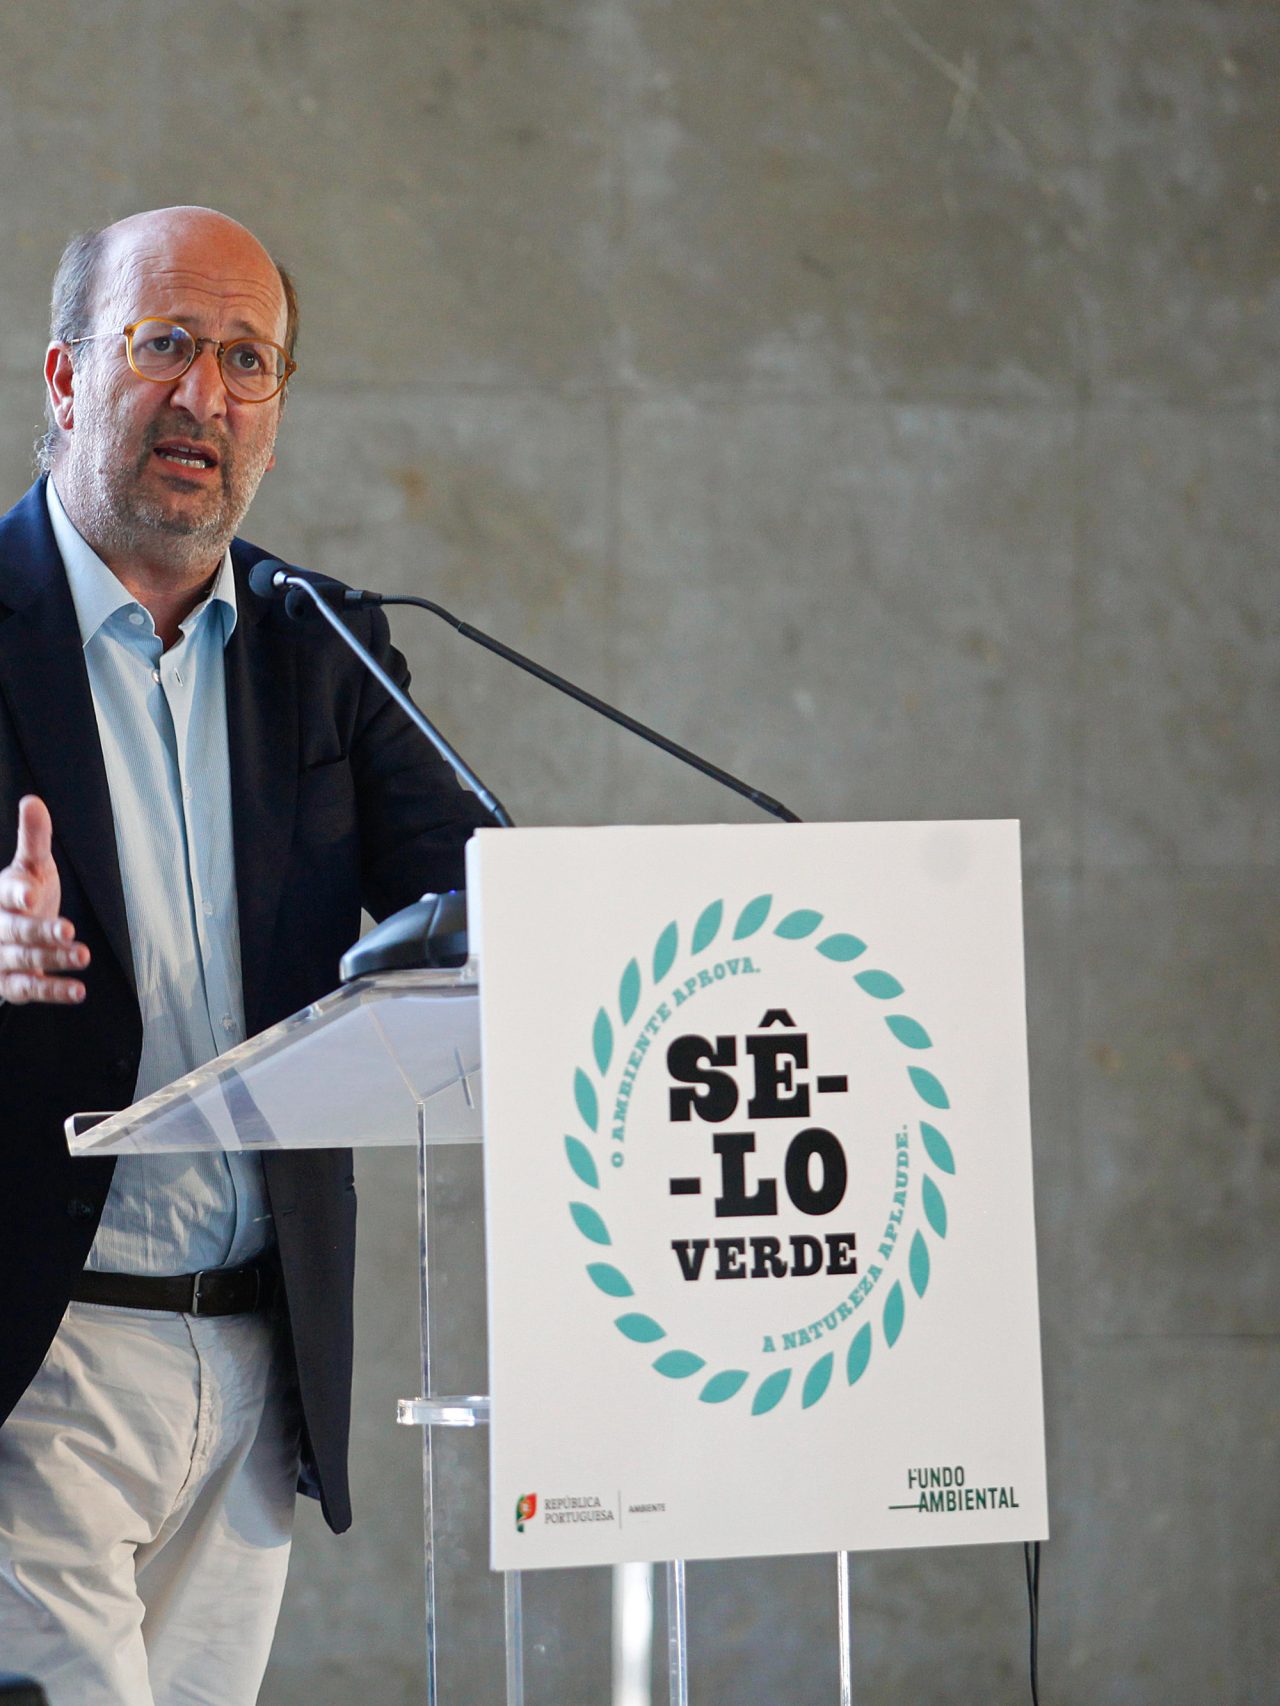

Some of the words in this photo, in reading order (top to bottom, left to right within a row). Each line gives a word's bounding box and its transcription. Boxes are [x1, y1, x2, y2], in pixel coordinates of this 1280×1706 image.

[671, 956, 761, 1007] APROVA.
[611, 1001, 673, 1143] AMBIENTE
[666, 1008, 848, 1123] SÊ-
[611, 1151, 624, 1168] O
[669, 1127, 848, 1218] -LO
[671, 1232, 857, 1281] VERDE
[762, 1335, 776, 1353] A
[782, 1264, 883, 1350] NATUREZA
[878, 1124, 909, 1261] APLAUDE.
[908, 1466, 966, 1489] FUNDO
[544, 1496, 602, 1511] REPÚBLICA
[544, 1509, 615, 1525] PORTUGUESA
[628, 1502, 667, 1513] AMBIENTE
[918, 1486, 1020, 1513] AMBIENTAL
